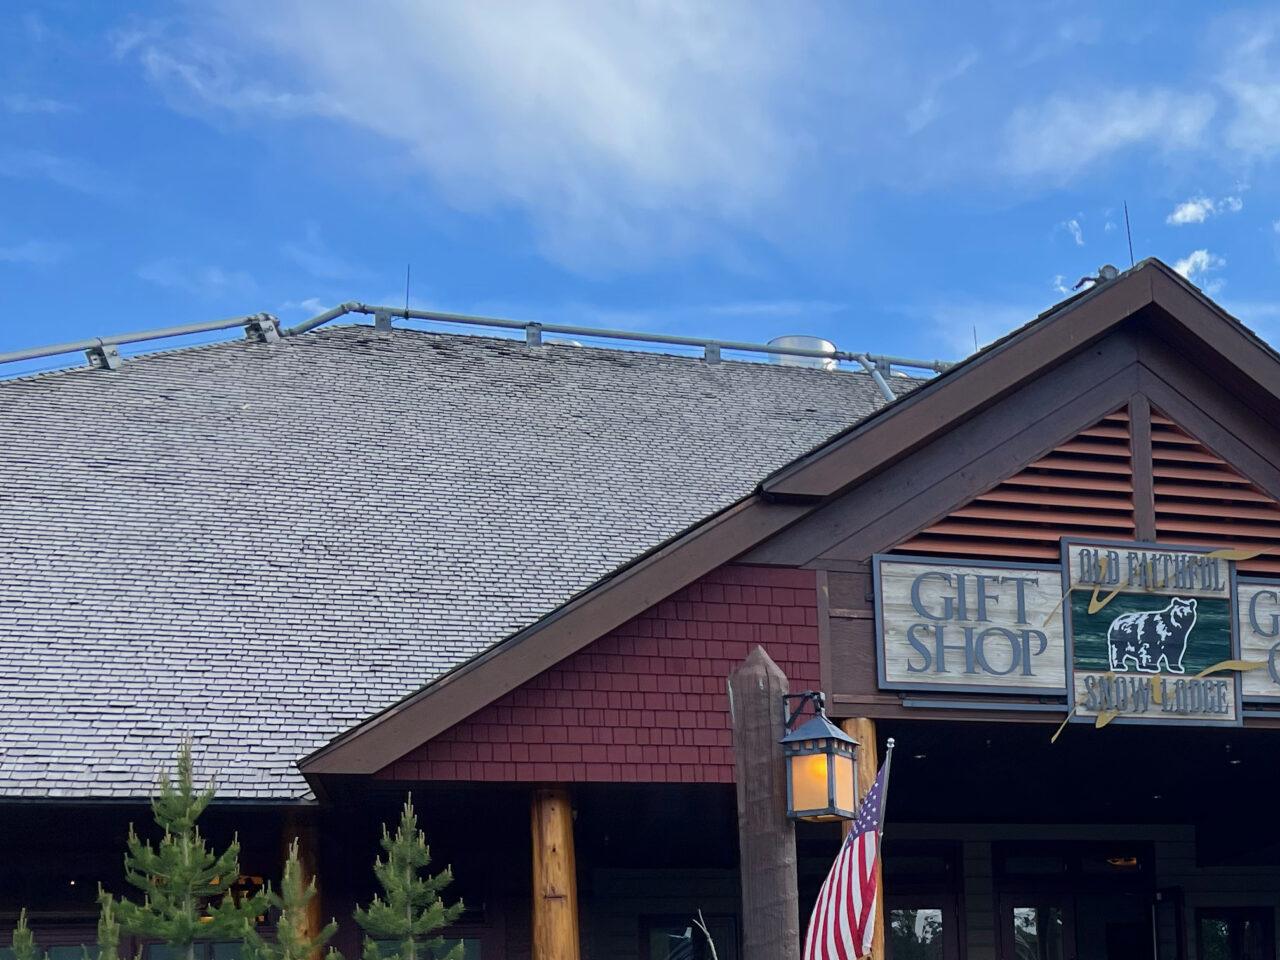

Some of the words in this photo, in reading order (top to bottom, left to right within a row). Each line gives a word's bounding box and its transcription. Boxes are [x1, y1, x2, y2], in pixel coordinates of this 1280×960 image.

[1078, 548, 1120, 585] OLD
[1126, 551, 1226, 592] FAITHFUL
[911, 571, 1039, 625] GIFT
[907, 624, 1048, 676] SHOP
[1084, 675, 1152, 712] SNOW
[1160, 680, 1230, 714] LODGE
